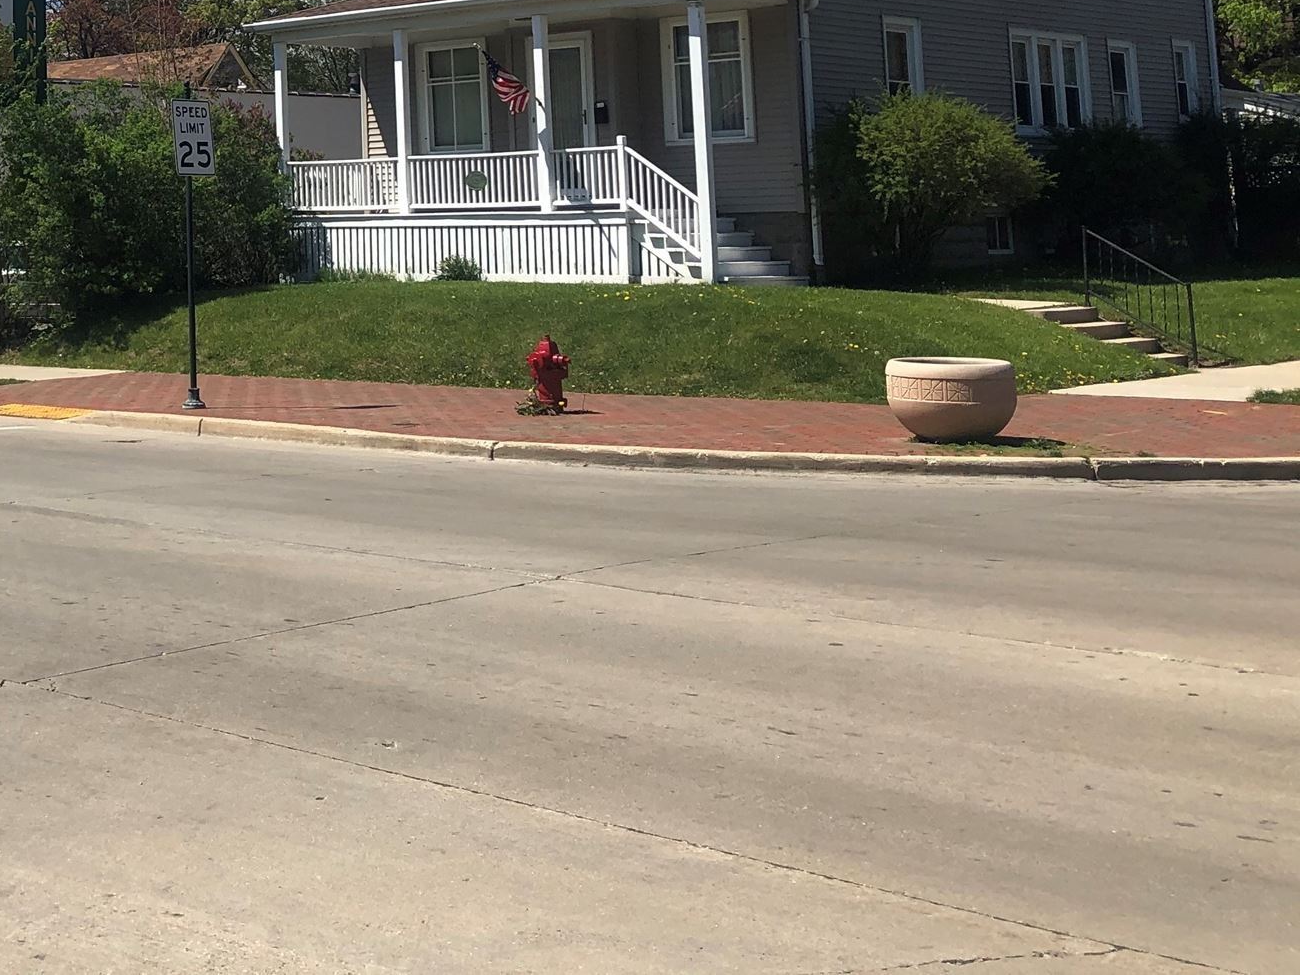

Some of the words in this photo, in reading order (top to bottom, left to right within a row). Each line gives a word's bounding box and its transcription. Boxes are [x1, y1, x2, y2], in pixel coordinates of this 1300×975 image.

[175, 106, 208, 118] SPEED
[180, 122, 205, 134] LIMIT
[179, 141, 211, 168] 25
